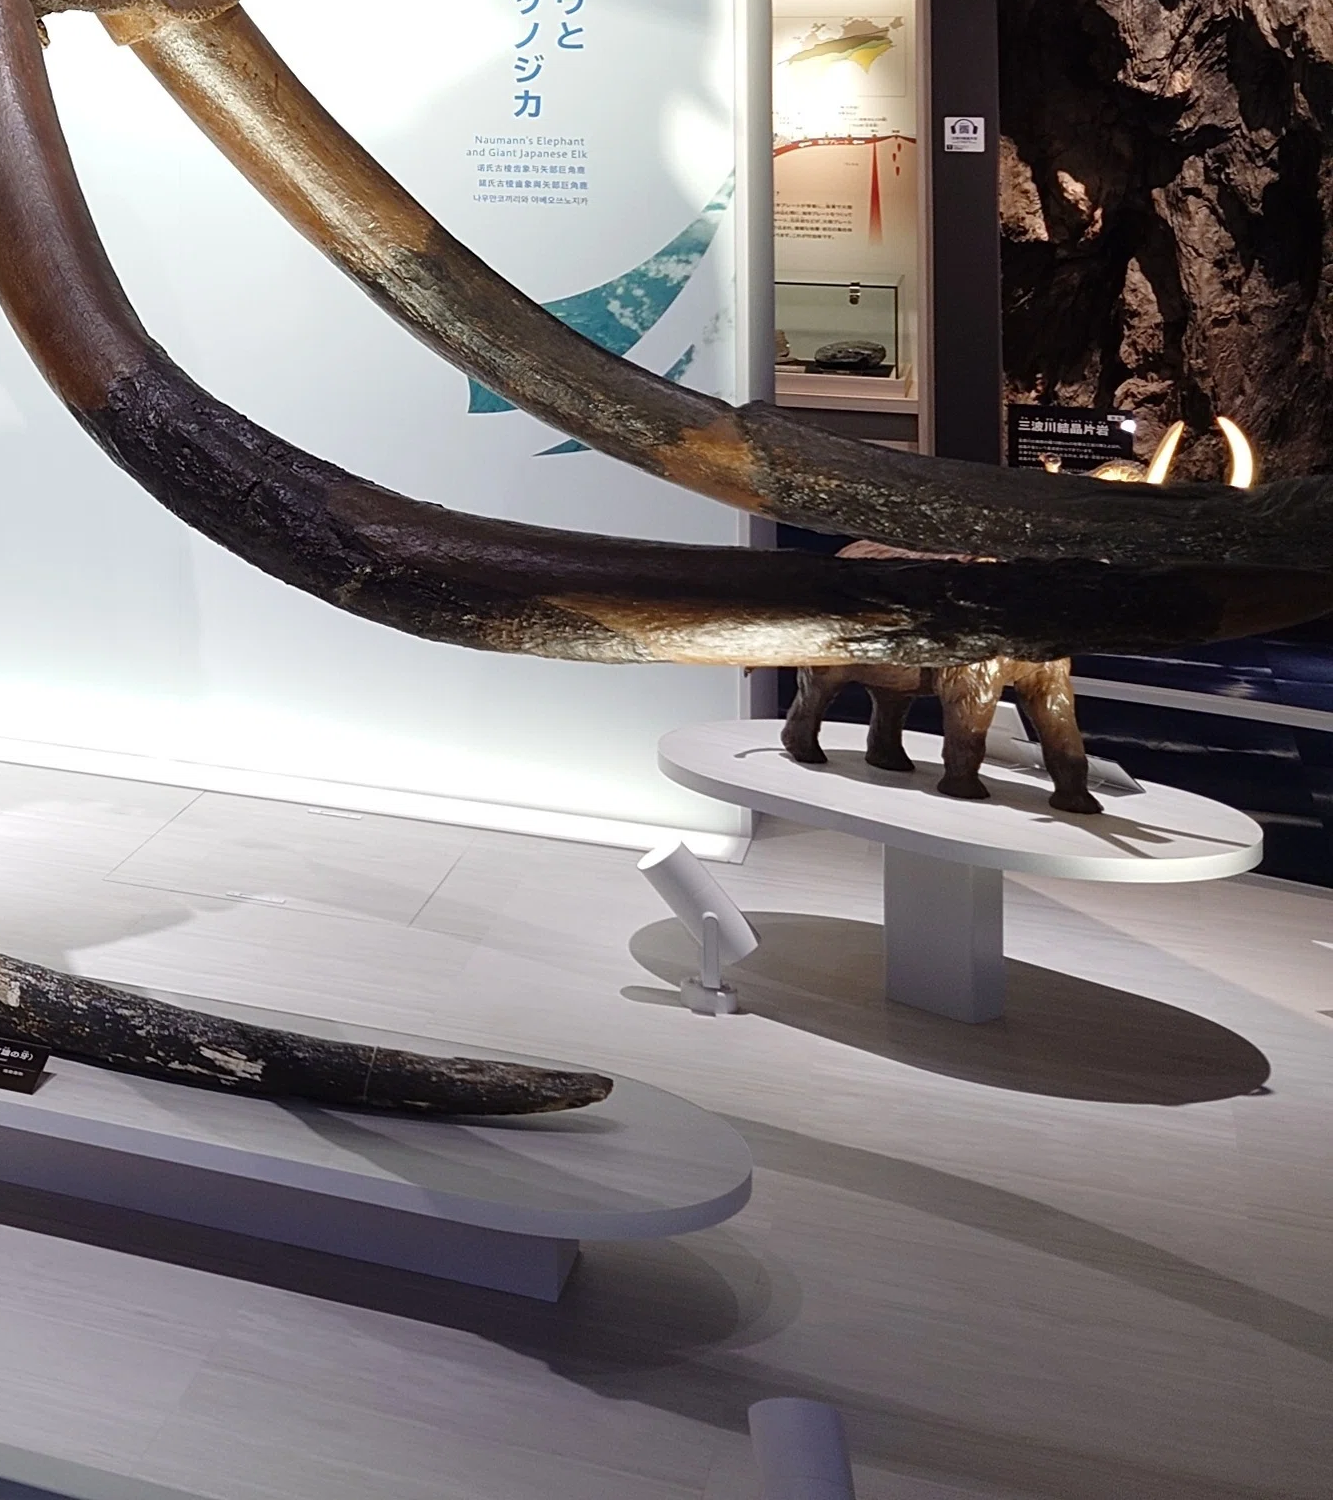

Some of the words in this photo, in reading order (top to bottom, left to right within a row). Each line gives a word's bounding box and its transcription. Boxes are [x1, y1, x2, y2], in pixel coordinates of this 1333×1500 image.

[474, 135, 534, 146] Naumann's
[536, 136, 585, 147] Elephant
[466, 148, 485, 157] and
[488, 148, 517, 157] Giant
[519, 149, 568, 159] Japanese
[570, 150, 588, 159] Elk
[1017, 419, 1110, 437] 三波川結晶片岩
